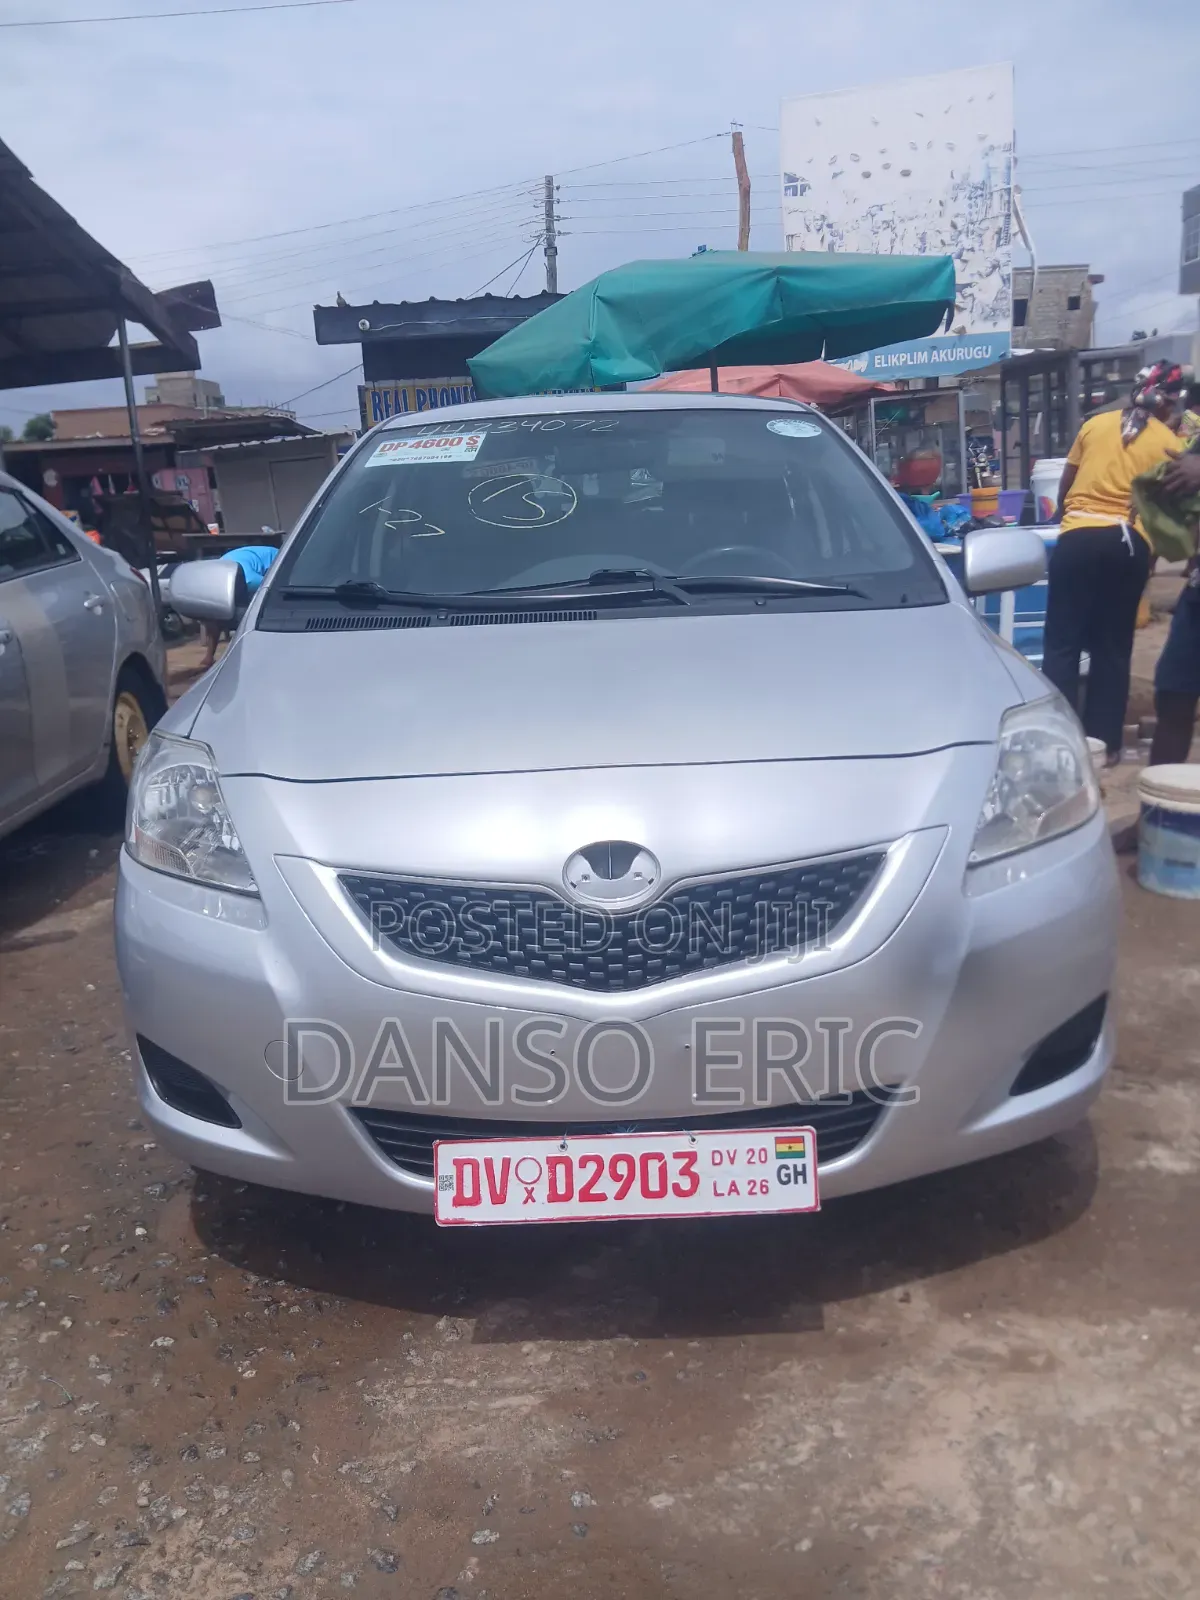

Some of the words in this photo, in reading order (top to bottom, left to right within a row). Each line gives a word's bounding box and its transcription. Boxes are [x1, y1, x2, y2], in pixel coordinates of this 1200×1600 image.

[874, 351, 929, 369] ELIKPLIM
[930, 345, 992, 364] AKURUGU
[378, 442, 408, 453] DP
[407, 436, 464, 450] 4600
[465, 435, 481, 446] S
[711, 1149, 738, 1167] DV
[746, 1147, 769, 1166] 20
[452, 1156, 512, 1208] DV
[546, 1150, 701, 1204] D2903
[776, 1163, 808, 1186] GH
[712, 1179, 741, 1198] LA
[747, 1179, 770, 1196] 26
